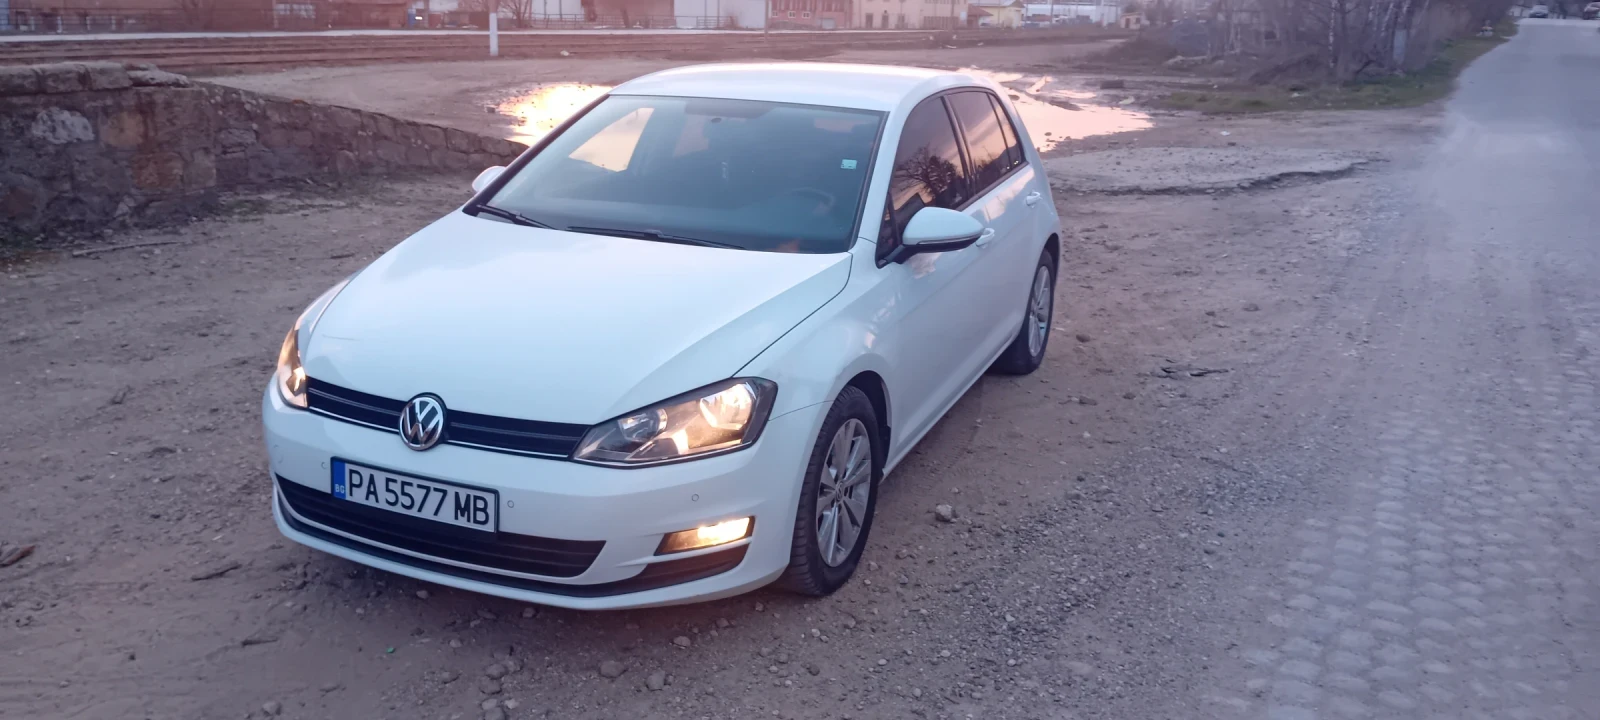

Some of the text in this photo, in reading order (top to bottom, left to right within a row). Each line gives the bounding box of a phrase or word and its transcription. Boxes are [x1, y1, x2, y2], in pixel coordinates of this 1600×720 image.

[400, 397, 443, 451] VW
[335, 483, 345, 494] BG
[349, 469, 489, 526] PA 5577 MB
